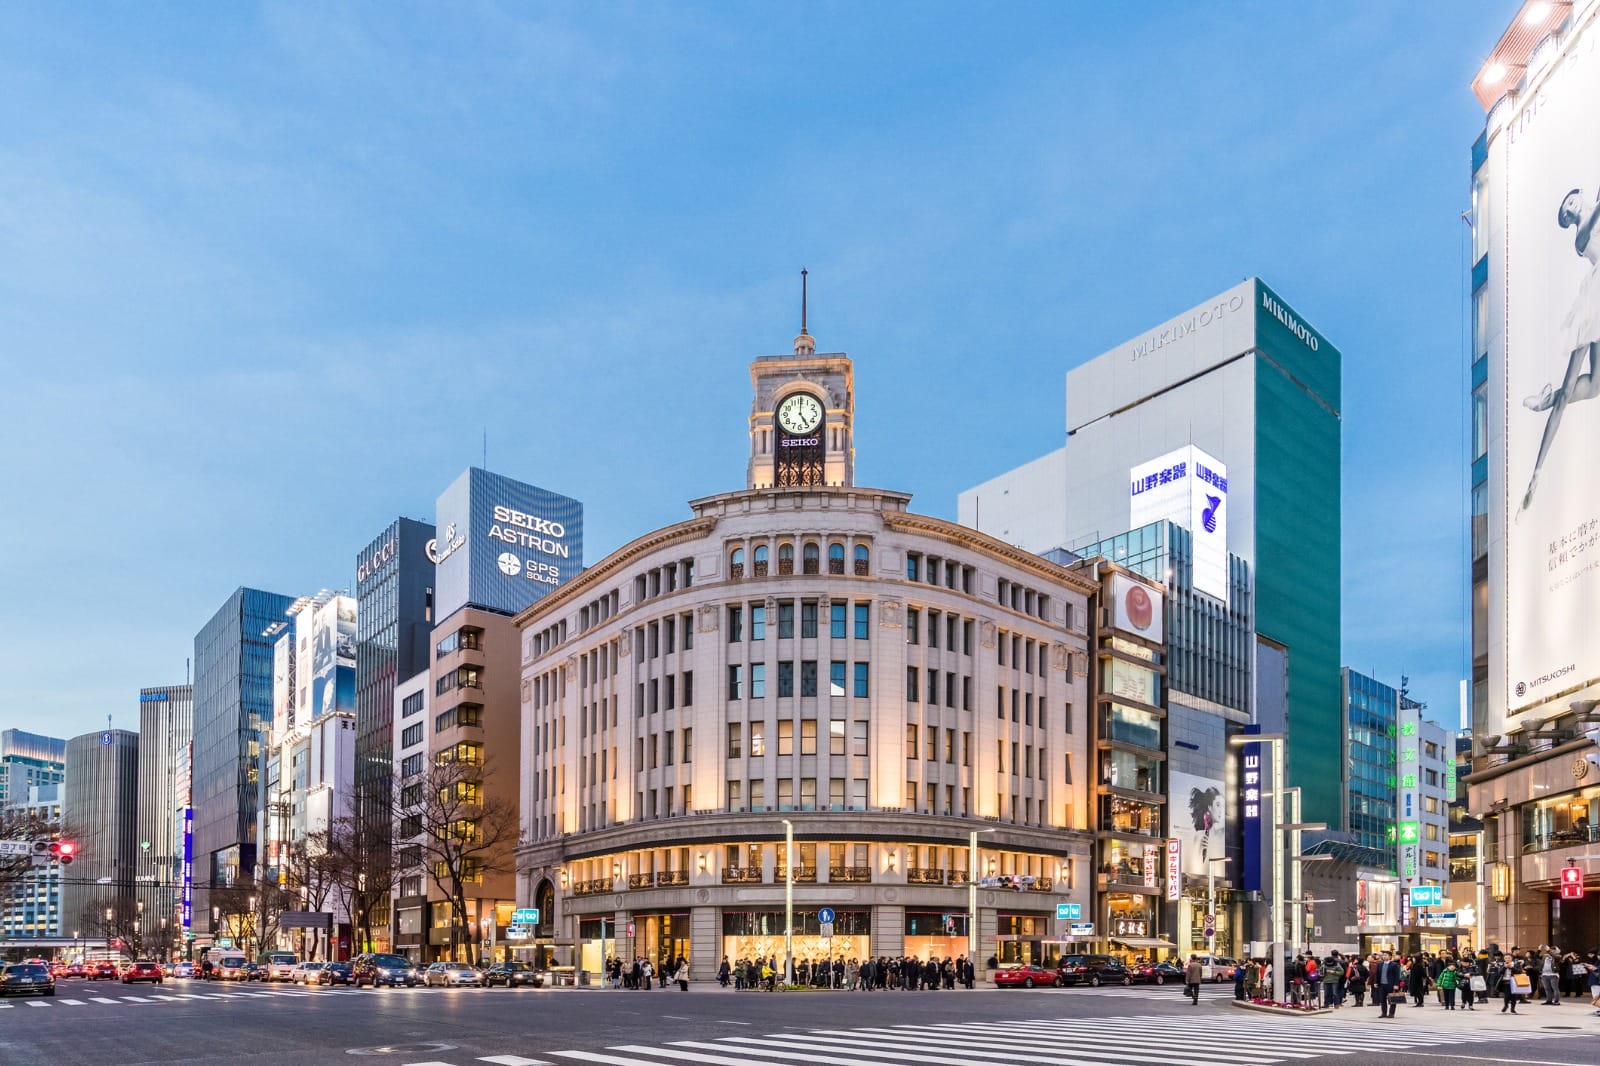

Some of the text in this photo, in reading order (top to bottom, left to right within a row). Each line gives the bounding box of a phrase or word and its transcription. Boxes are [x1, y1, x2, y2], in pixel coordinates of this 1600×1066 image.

[1131, 295, 1244, 362] MIKIMOTO
[1262, 291, 1318, 351] MIKIMOTO
[782, 439, 819, 447] SEIKO
[1131, 461, 1187, 496] 山野楽器
[1196, 461, 1228, 494] 山野楽器
[494, 505, 566, 538] SEIKO
[488, 524, 569, 559] ASTRON
[526, 559, 559, 577] GPS
[526, 571, 559, 586] SOLAR
[1529, 663, 1576, 689] MITSUKOSHI
[1401, 825, 1417, 841] 本
